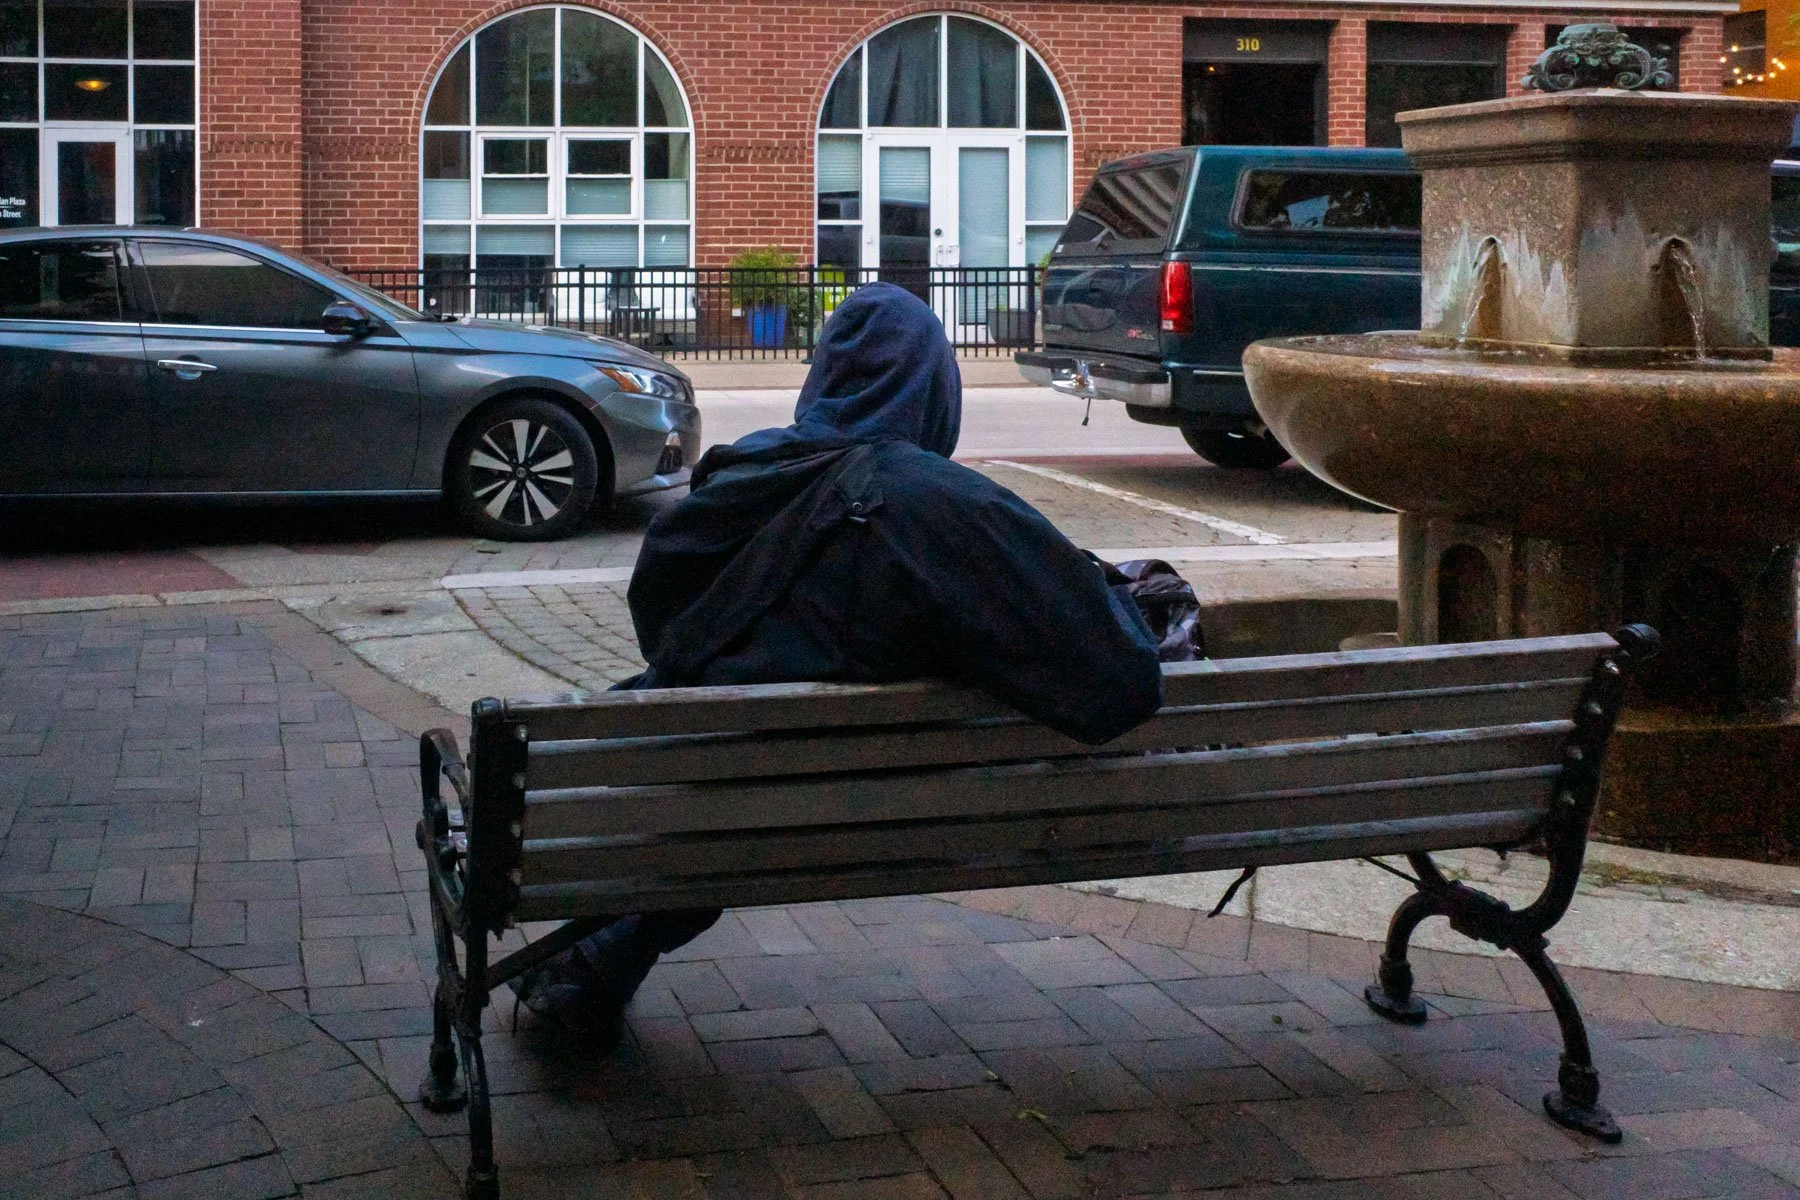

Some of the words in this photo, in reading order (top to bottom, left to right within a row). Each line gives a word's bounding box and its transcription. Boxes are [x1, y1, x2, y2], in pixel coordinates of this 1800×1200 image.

[1236, 38, 1260, 51] 310
[9, 196, 26, 205] Plaza
[3, 209, 21, 218] Street
